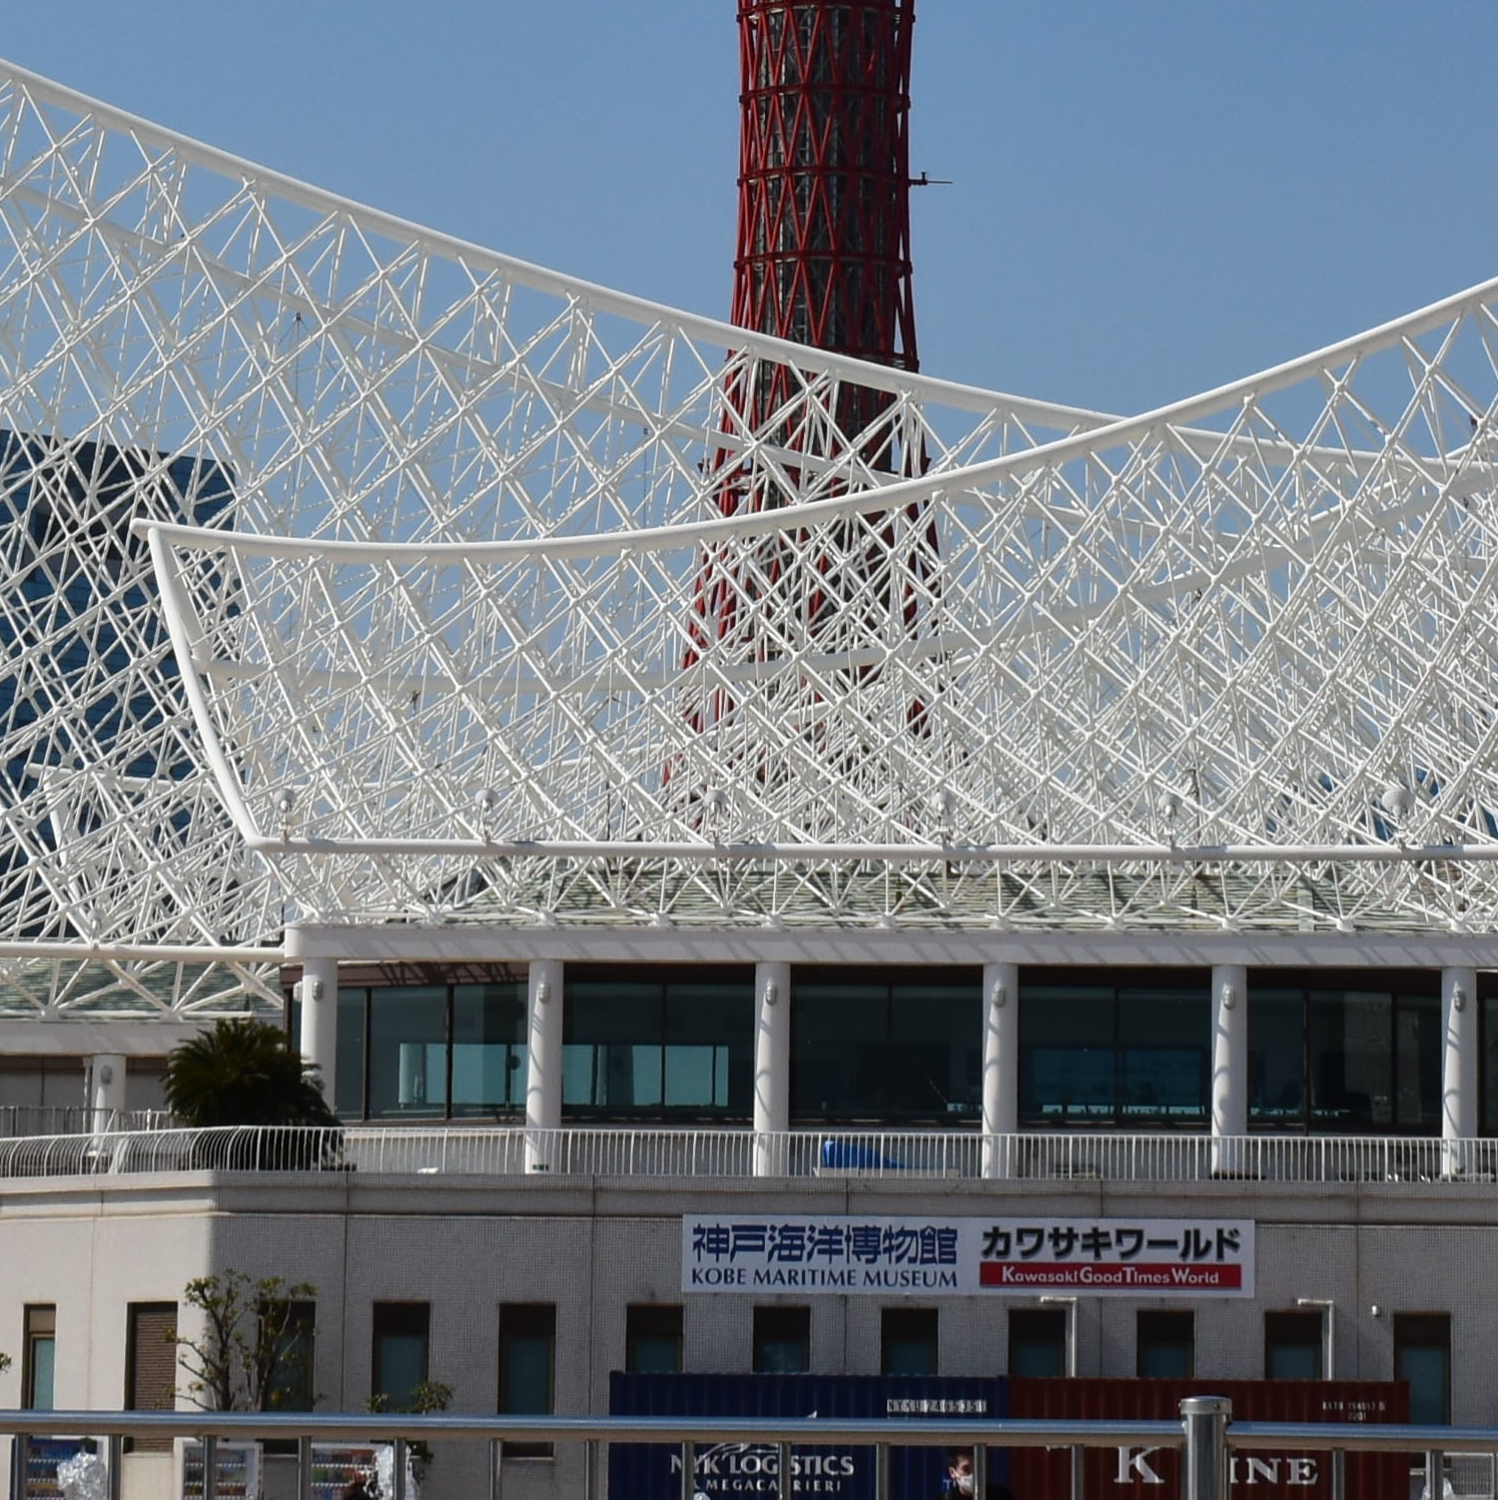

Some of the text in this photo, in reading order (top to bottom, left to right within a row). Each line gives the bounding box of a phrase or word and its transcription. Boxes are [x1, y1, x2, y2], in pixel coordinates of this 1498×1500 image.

[692, 1223, 958, 1265] 神戸海洋博物館
[981, 1226, 1240, 1261] カワサキワールド
[692, 1267, 958, 1288] KOBE MARITIME MUSEUM
[1002, 1266, 1078, 1283] Kawasaki
[1080, 1266, 1123, 1284] Good
[1171, 1268, 1219, 1285] World
[670, 1455, 854, 1476] NYK LOGSTICS
[1229, 1457, 1318, 1485] INE
[706, 1479, 841, 1492] MEGACARIERI
